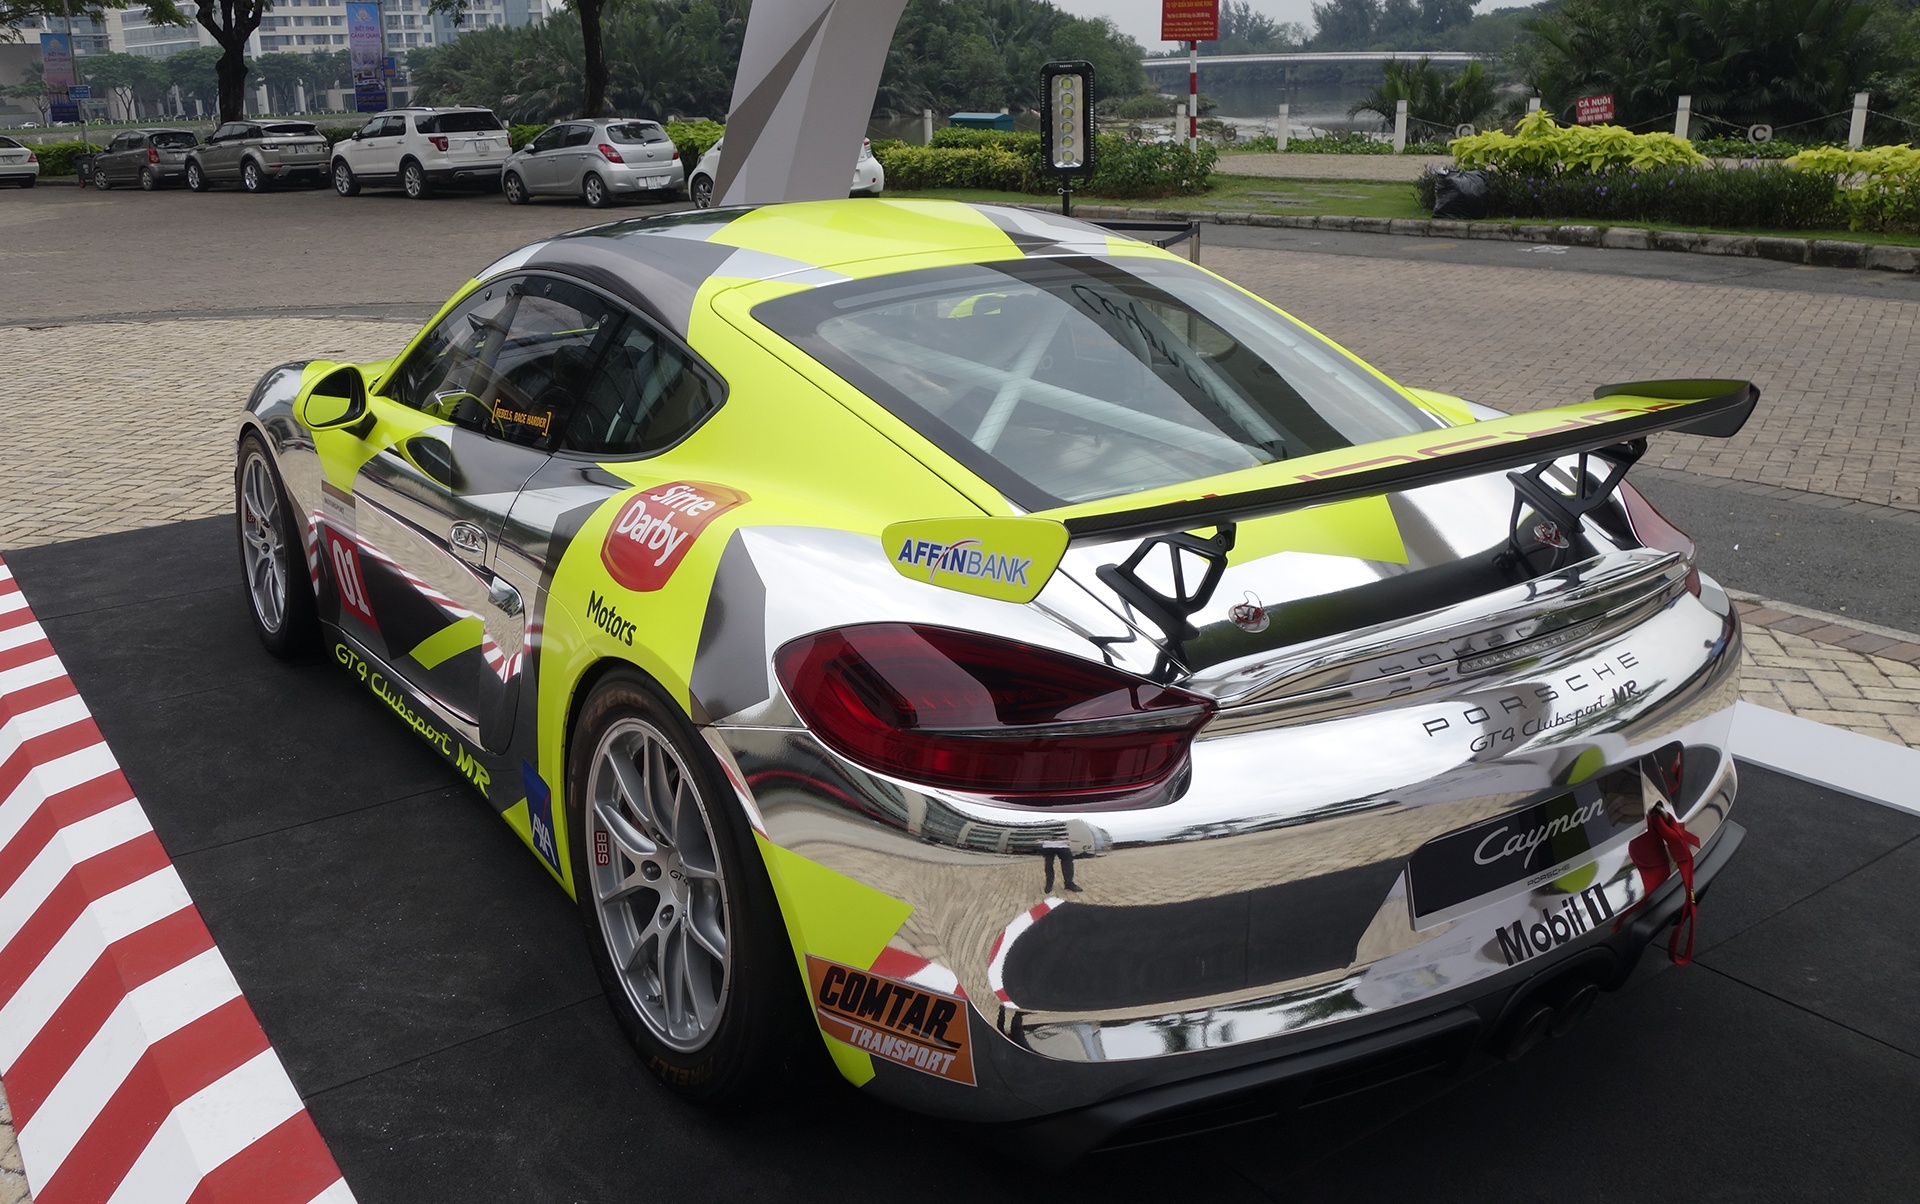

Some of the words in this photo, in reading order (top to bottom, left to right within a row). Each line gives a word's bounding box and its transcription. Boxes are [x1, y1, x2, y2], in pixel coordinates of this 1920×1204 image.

[513, 411, 527, 424] RACE
[616, 500, 688, 567] Darby
[651, 485, 716, 517] Sime
[332, 539, 371, 617] 01
[586, 590, 637, 647] Motors
[1422, 652, 1639, 737] PORSCHE
[1470, 726, 1516, 753] GT4
[1522, 694, 1607, 736] Clubsport
[1611, 679, 1640, 704] MR
[371, 672, 452, 755] Clubsport
[455, 742, 491, 799] MR
[532, 813, 557, 867] AXA
[596, 832, 609, 864] BBS
[1474, 798, 1604, 869] Cayman
[1527, 863, 1570, 886] PORSCHE
[1495, 896, 1587, 967] Mobil
[1584, 885, 1611, 924] 1
[819, 965, 960, 1046] COMTAR
[850, 1025, 957, 1075] TRANSPORT
